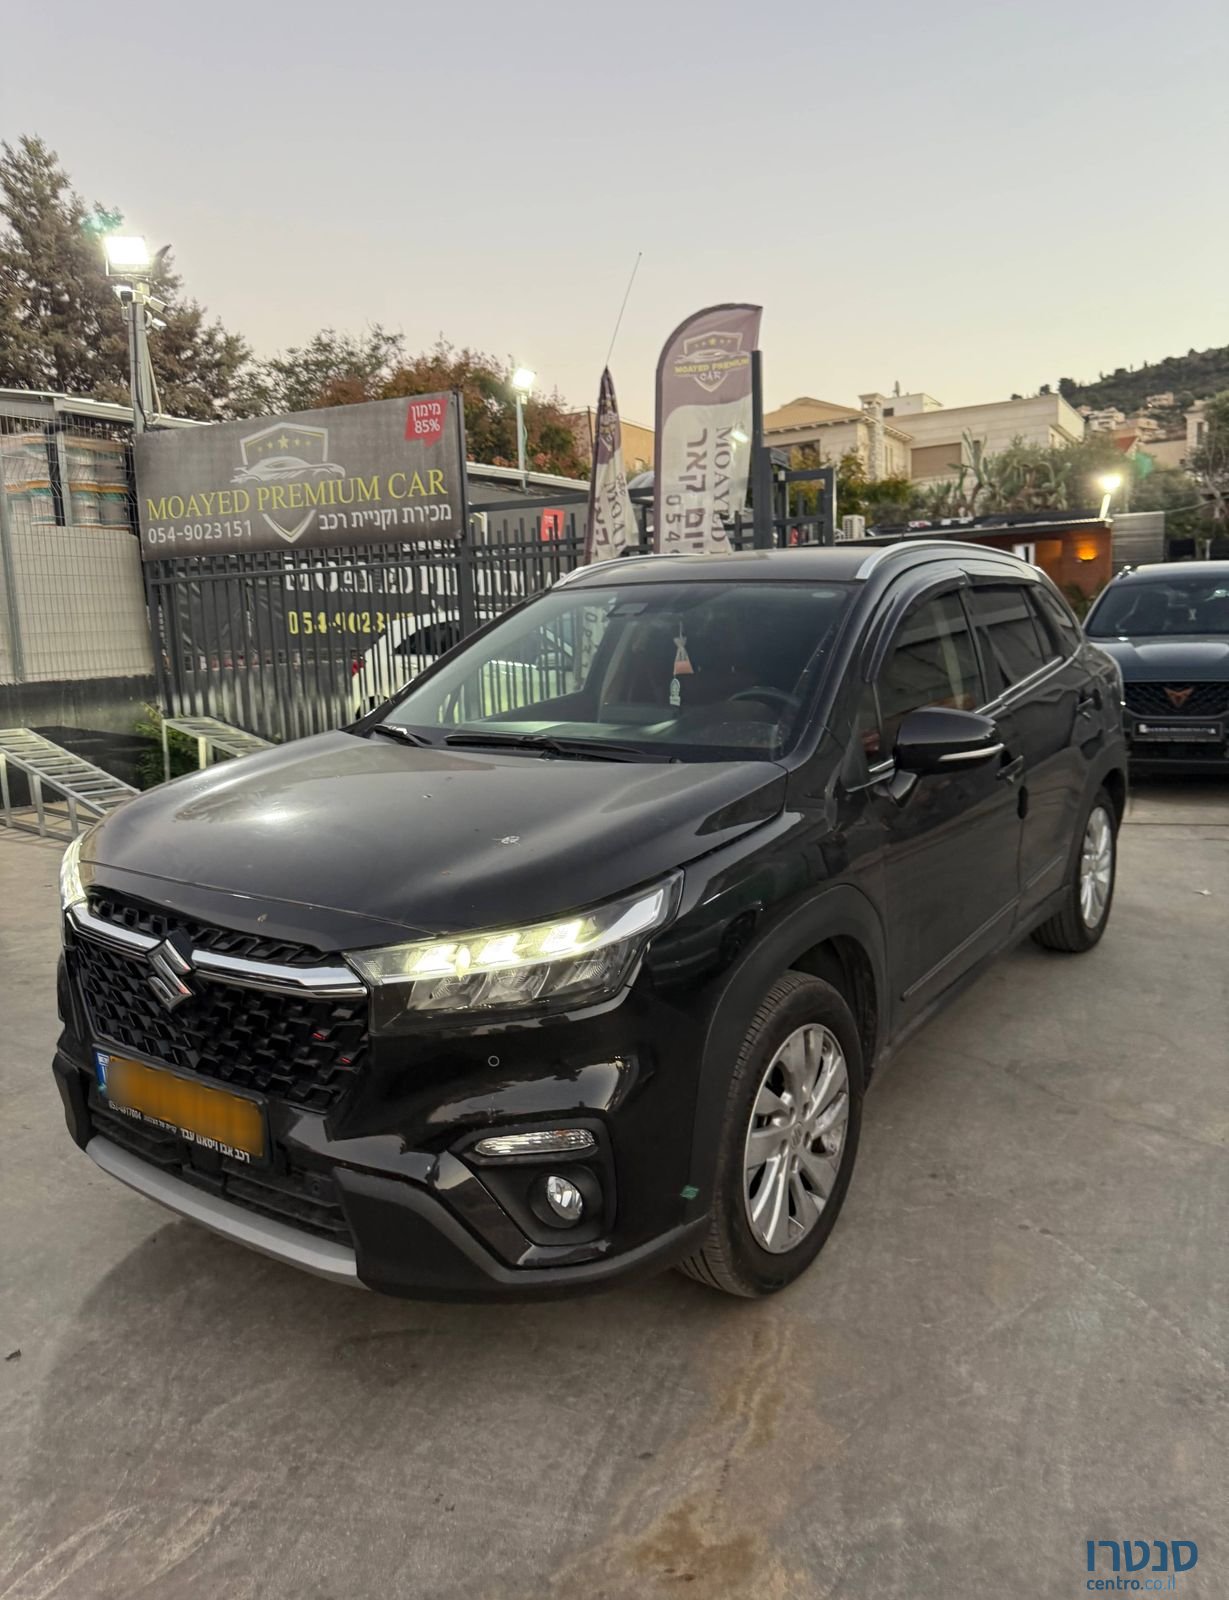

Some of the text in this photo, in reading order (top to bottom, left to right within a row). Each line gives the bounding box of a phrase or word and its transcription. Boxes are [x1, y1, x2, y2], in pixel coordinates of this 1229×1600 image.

[411, 403, 441, 421] מימון
[415, 418, 441, 433] 85%
[146, 469, 448, 521] MOAYED PREMIUM CAR
[319, 503, 452, 531] מכירת וקניית רכב
[148, 519, 252, 544] 054-9023151
